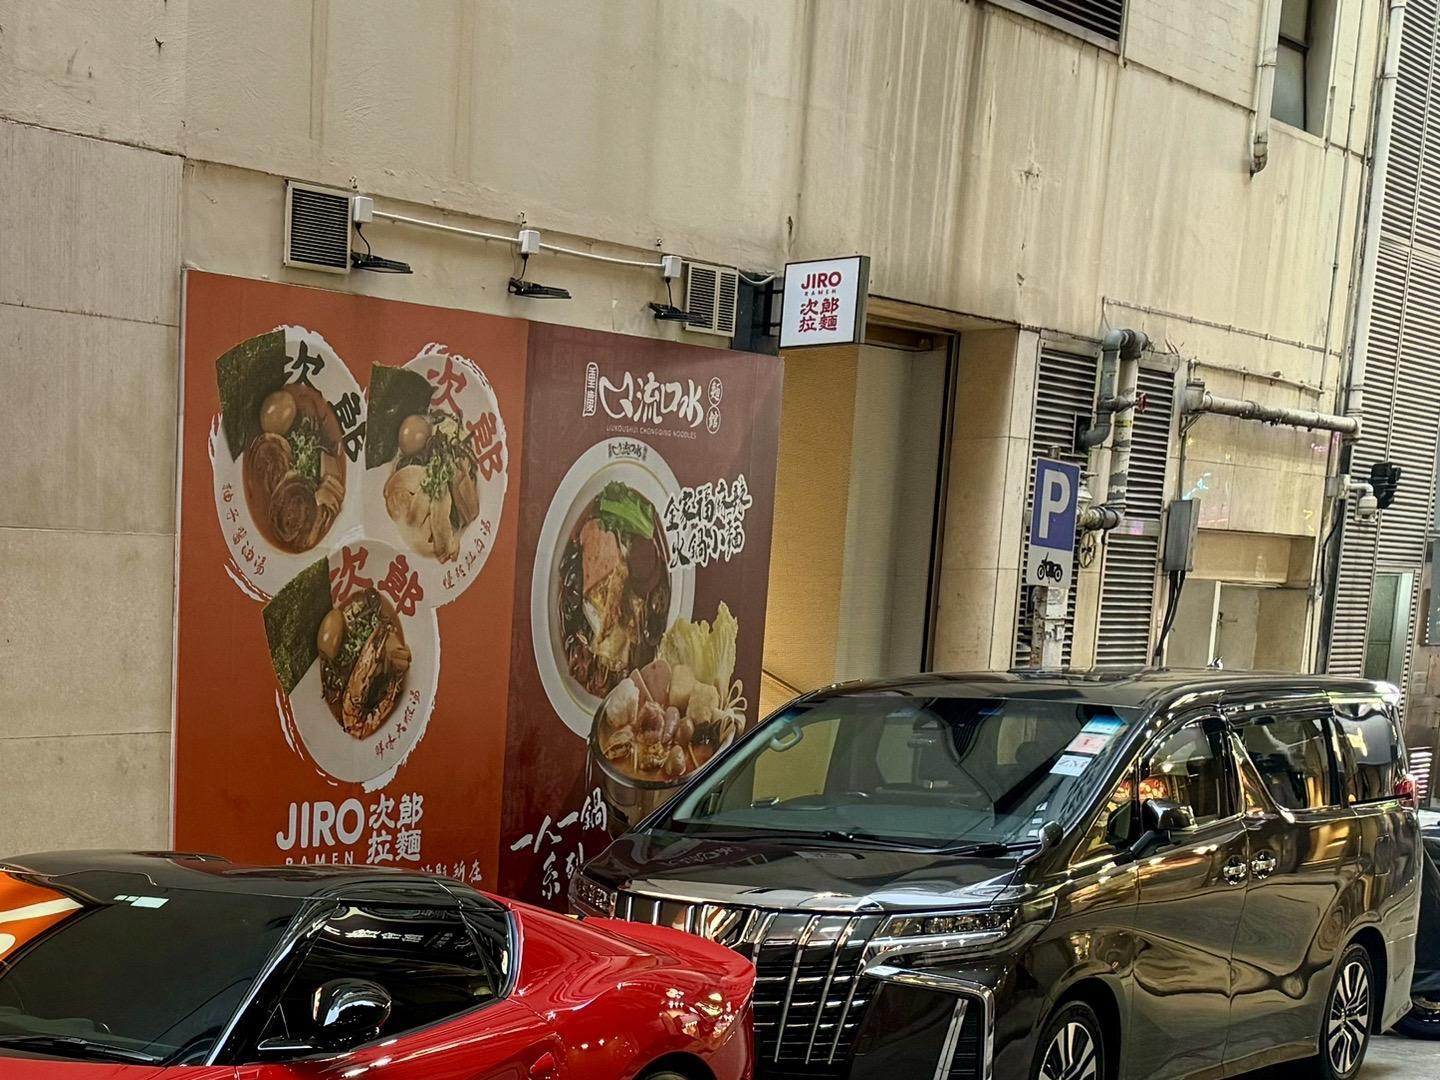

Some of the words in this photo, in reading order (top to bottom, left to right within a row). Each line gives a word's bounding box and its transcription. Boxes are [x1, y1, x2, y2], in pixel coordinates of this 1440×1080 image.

[801, 271, 842, 290] JIRO
[798, 314, 838, 333] 拉麵
[1038, 469, 1071, 539] P
[276, 798, 365, 850] JIRO
[368, 792, 424, 829] 次郎
[366, 828, 422, 864] 拉麵
